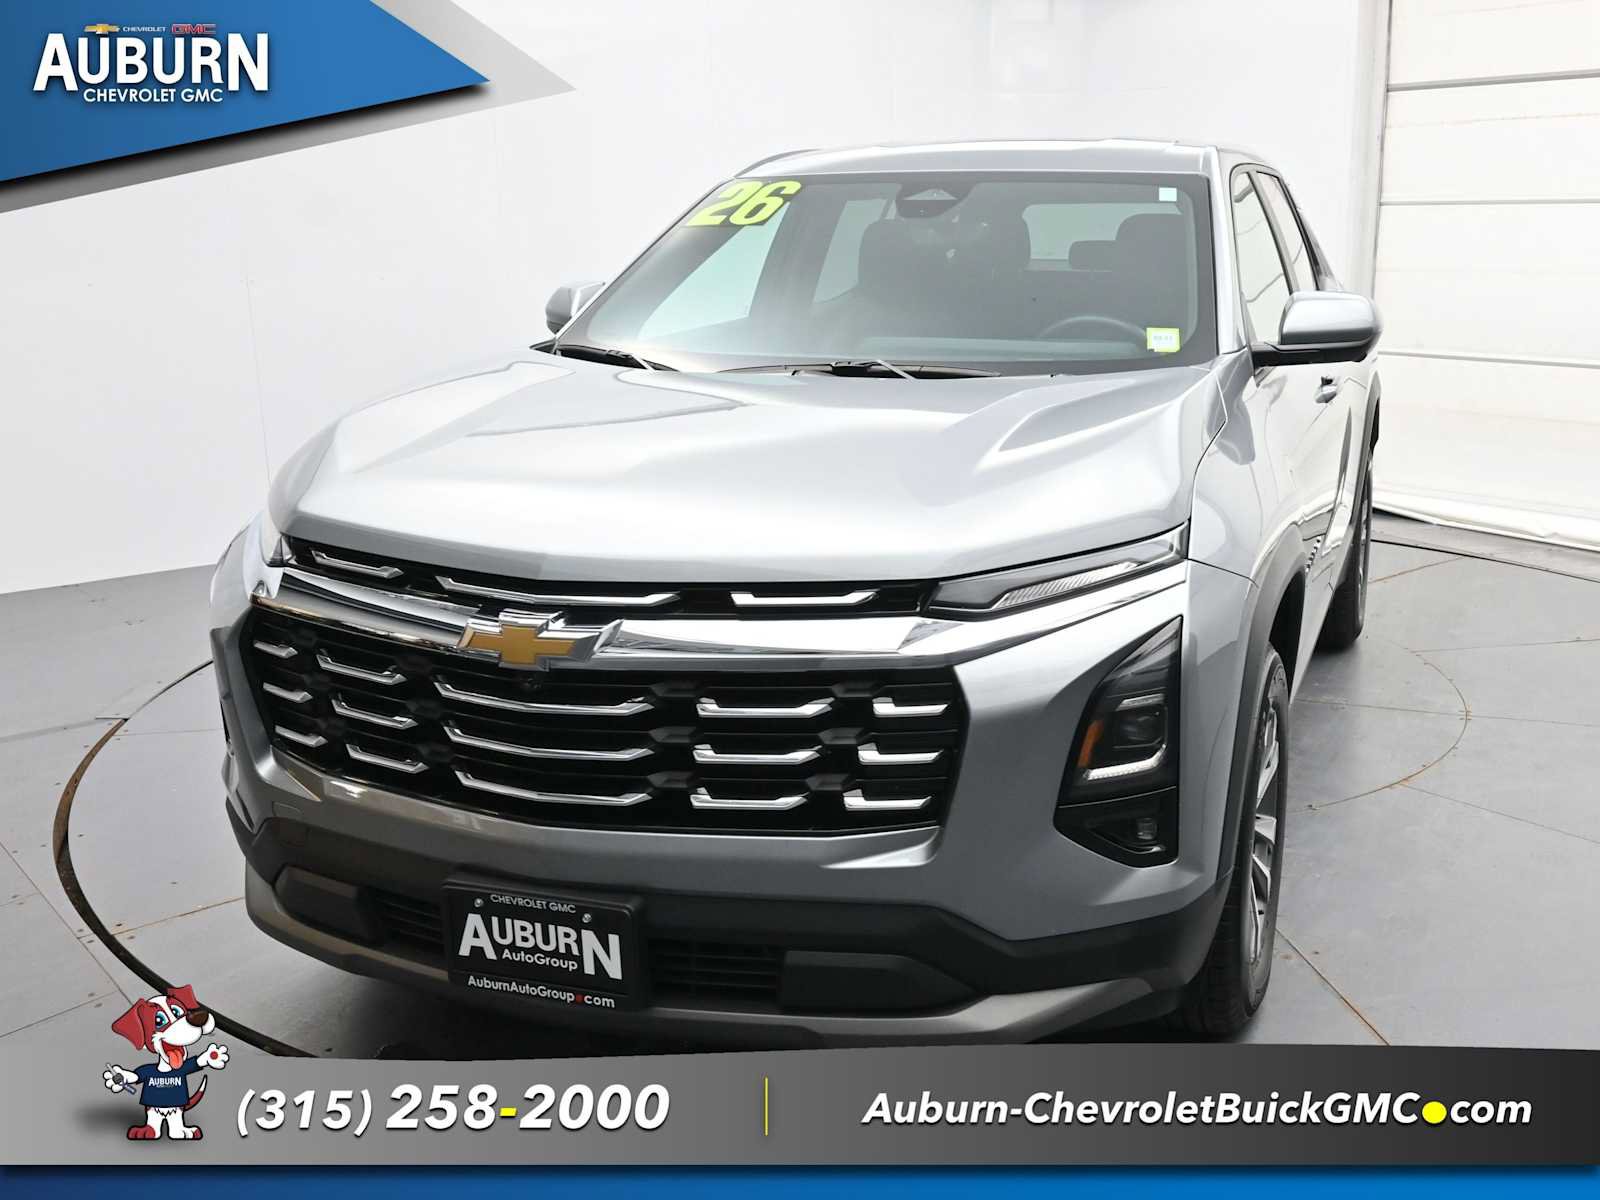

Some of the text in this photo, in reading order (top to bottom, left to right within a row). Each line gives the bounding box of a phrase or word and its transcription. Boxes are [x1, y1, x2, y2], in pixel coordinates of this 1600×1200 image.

[687, 180, 802, 226] 26
[490, 894, 577, 914] CHEVROLET GMC
[458, 912, 623, 980] AUBURN
[502, 949, 578, 972] AutoGroup
